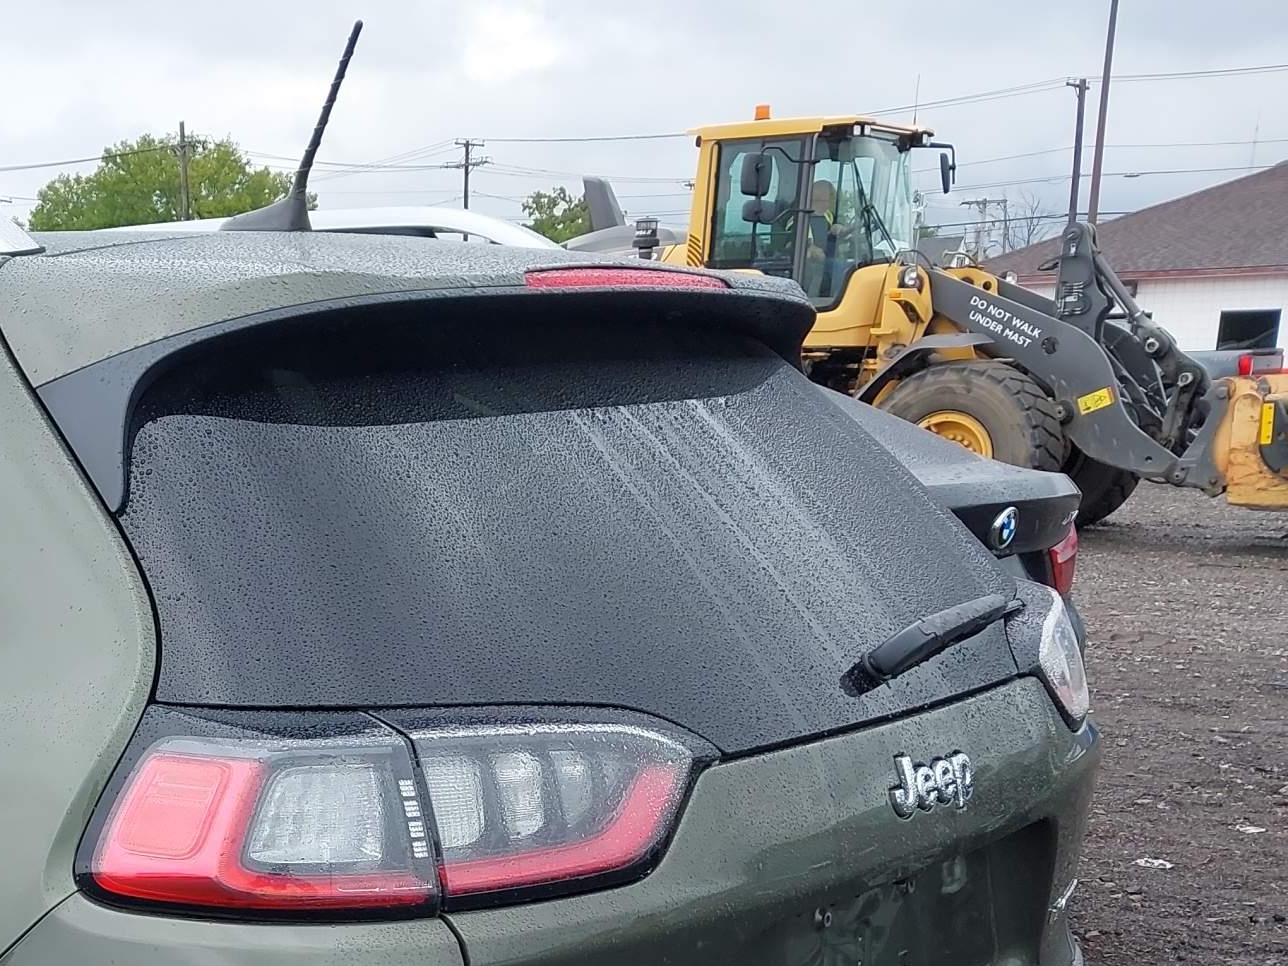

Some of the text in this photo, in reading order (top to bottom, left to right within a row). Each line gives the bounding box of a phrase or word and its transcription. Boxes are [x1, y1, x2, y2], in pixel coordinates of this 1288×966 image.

[969, 311, 1033, 347] UNDER MAST
[970, 296, 1043, 338] DO NOT WALK
[889, 751, 974, 819] Jeep
